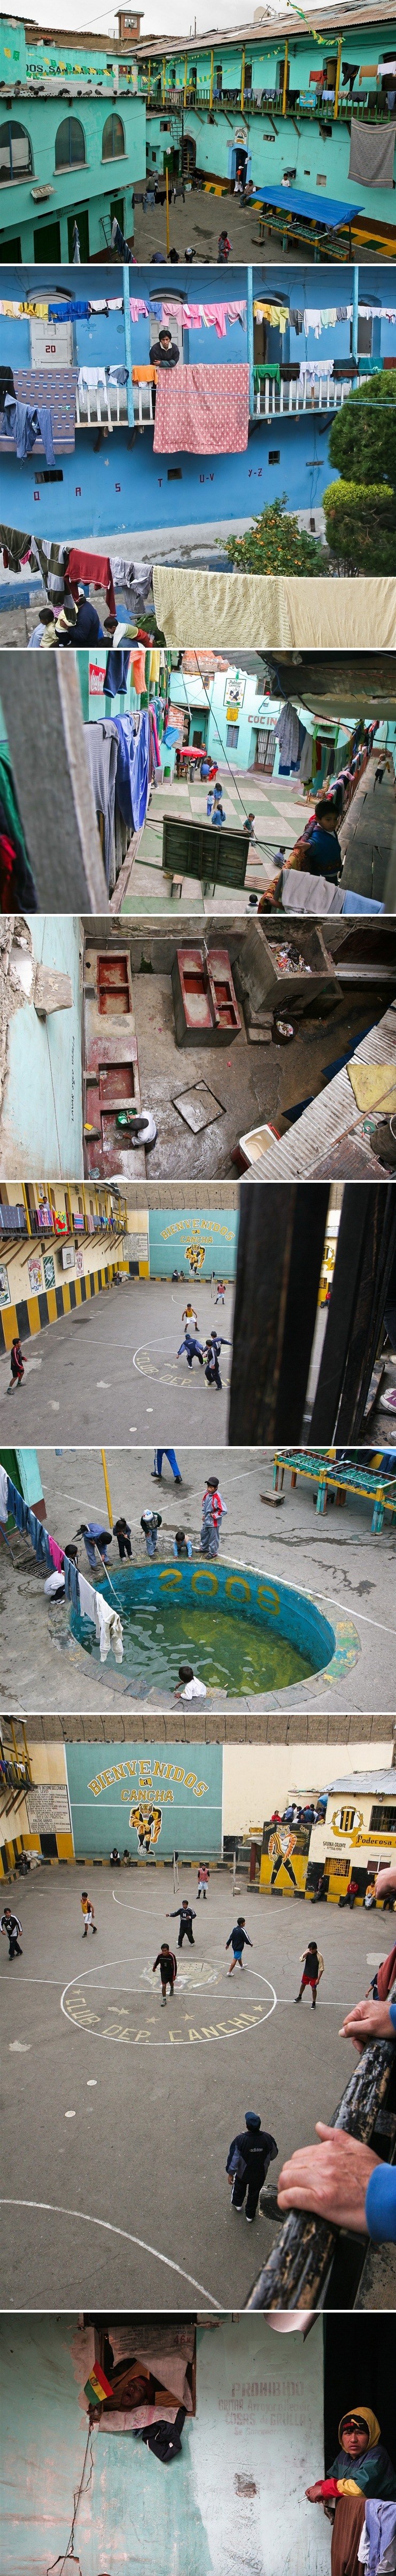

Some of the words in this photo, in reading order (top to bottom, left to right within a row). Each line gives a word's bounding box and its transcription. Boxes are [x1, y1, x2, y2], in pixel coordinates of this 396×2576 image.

[34, 491, 41, 501] Q
[115, 483, 121, 492] S
[158, 478, 163, 487] T
[160, 1219, 235, 1241] BIENVENIDOS
[180, 1236, 213, 1244] CANCHA
[136, 1357, 159, 1374] CLUB
[158, 1569, 280, 1615] 2008
[88, 1760, 209, 1797] BIENVENIDOS
[121, 1789, 174, 1802] CANCHA
[300, 1825, 309, 1835] 2008
[356, 1835, 392, 1846] Poderosa
[66, 1998, 102, 2025] CLUB
[168, 2013, 261, 2042] CANCHA
[231, 2381, 304, 2397] PROHIBIDO
